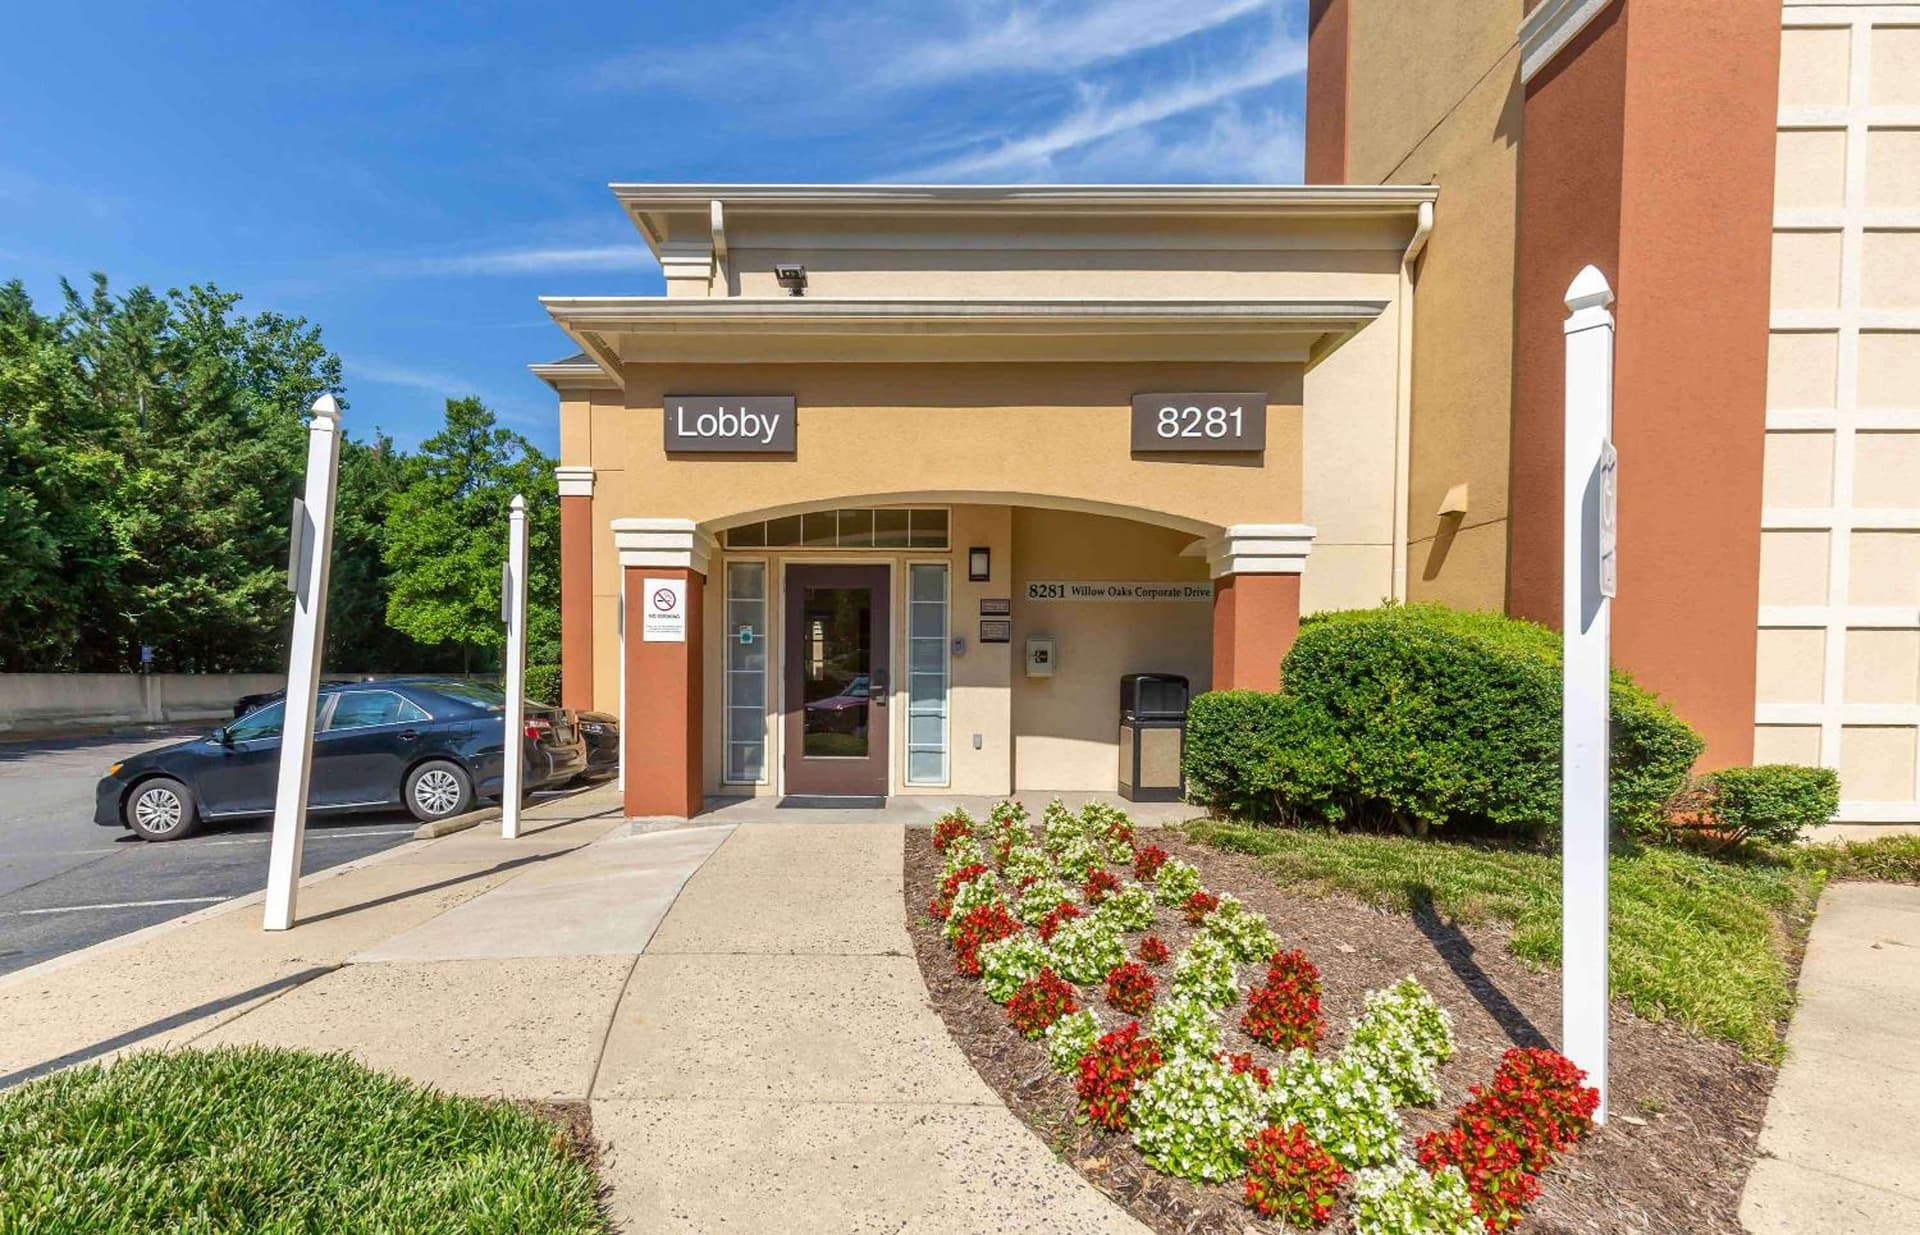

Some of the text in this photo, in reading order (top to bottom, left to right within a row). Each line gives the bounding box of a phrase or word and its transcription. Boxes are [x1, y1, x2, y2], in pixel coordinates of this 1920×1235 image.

[677, 406, 780, 443] Lobby
[1157, 406, 1243, 438] 8281
[1028, 584, 1211, 600] 8281 Willow Oaks Corporate Drive
